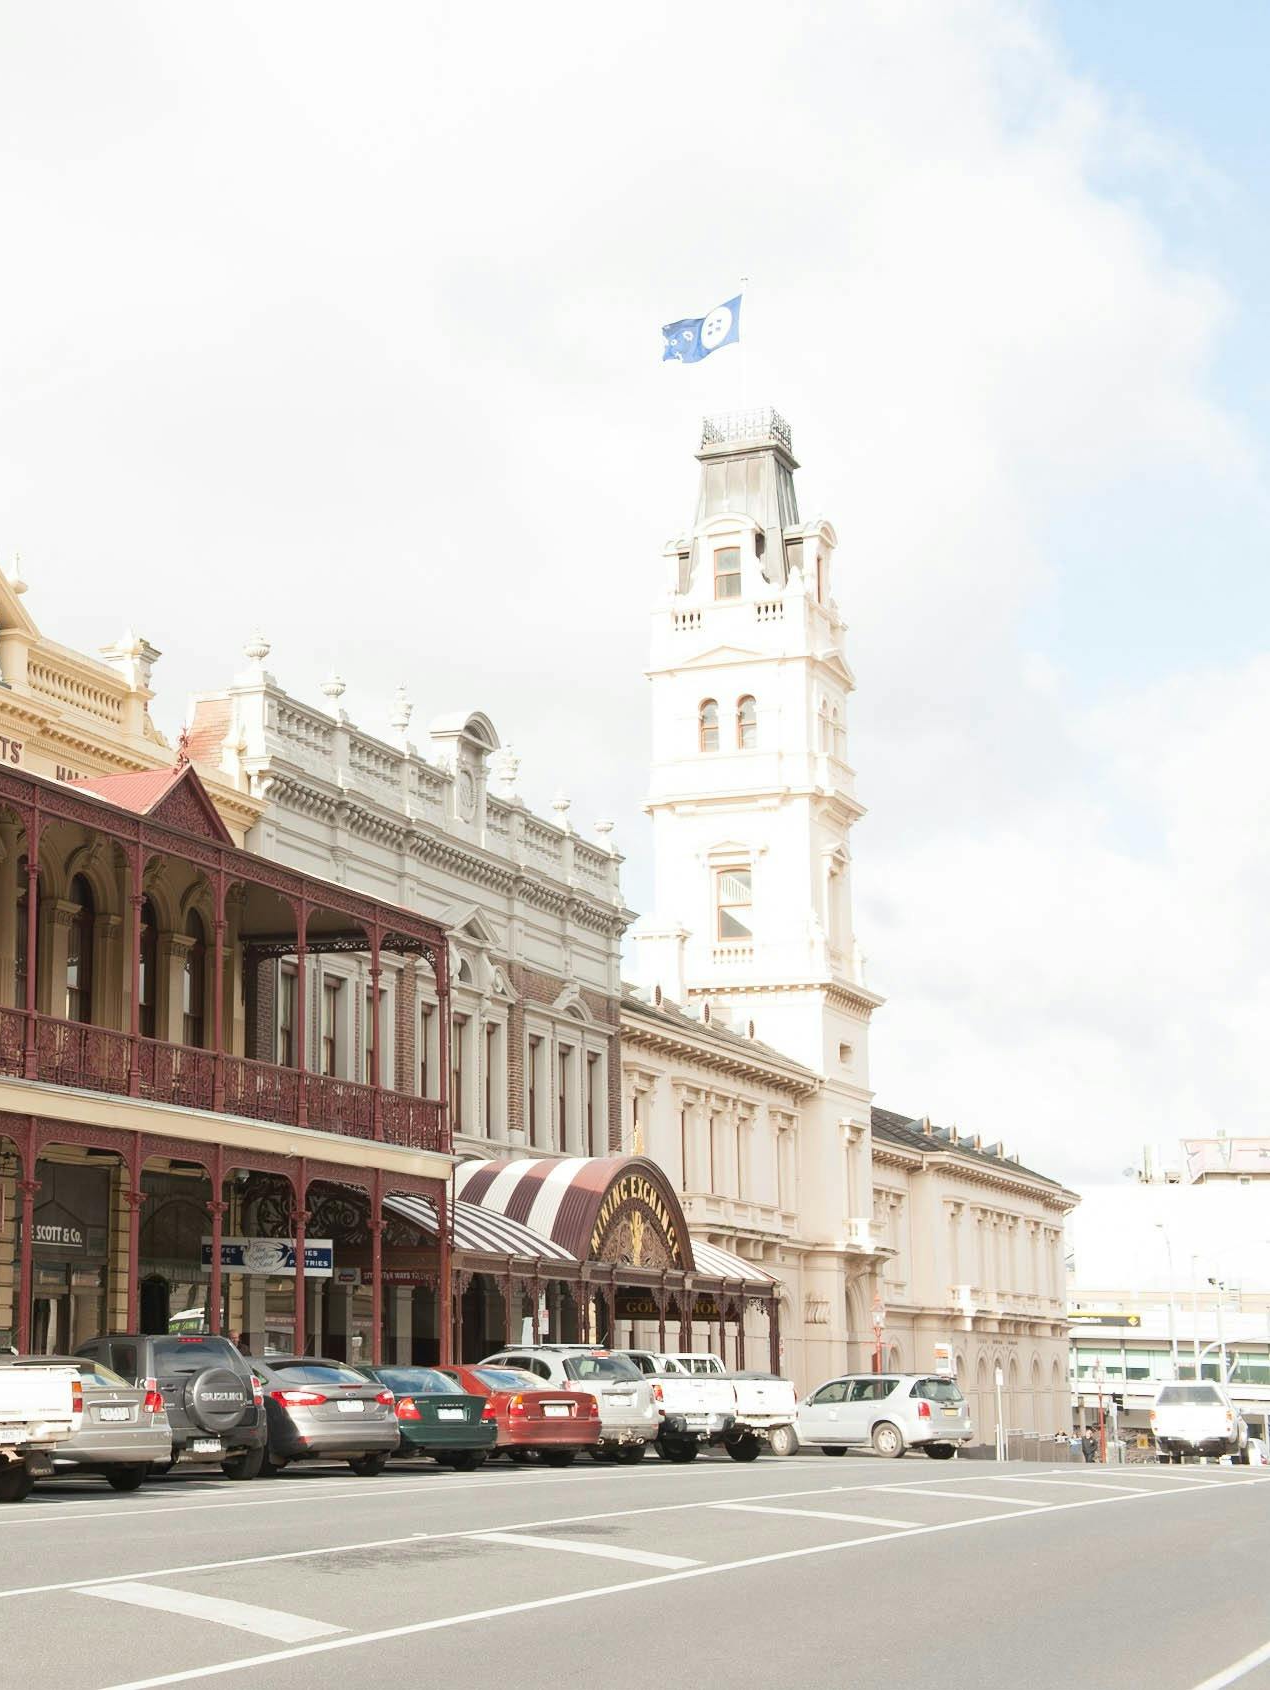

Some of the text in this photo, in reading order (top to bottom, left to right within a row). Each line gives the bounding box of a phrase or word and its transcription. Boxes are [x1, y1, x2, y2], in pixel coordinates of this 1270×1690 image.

[36, 1225, 62, 1241] SCOTT
[63, 1228, 70, 1242] &
[71, 1228, 83, 1243] Co.
[200, 1391, 243, 1401] SUZUKI
